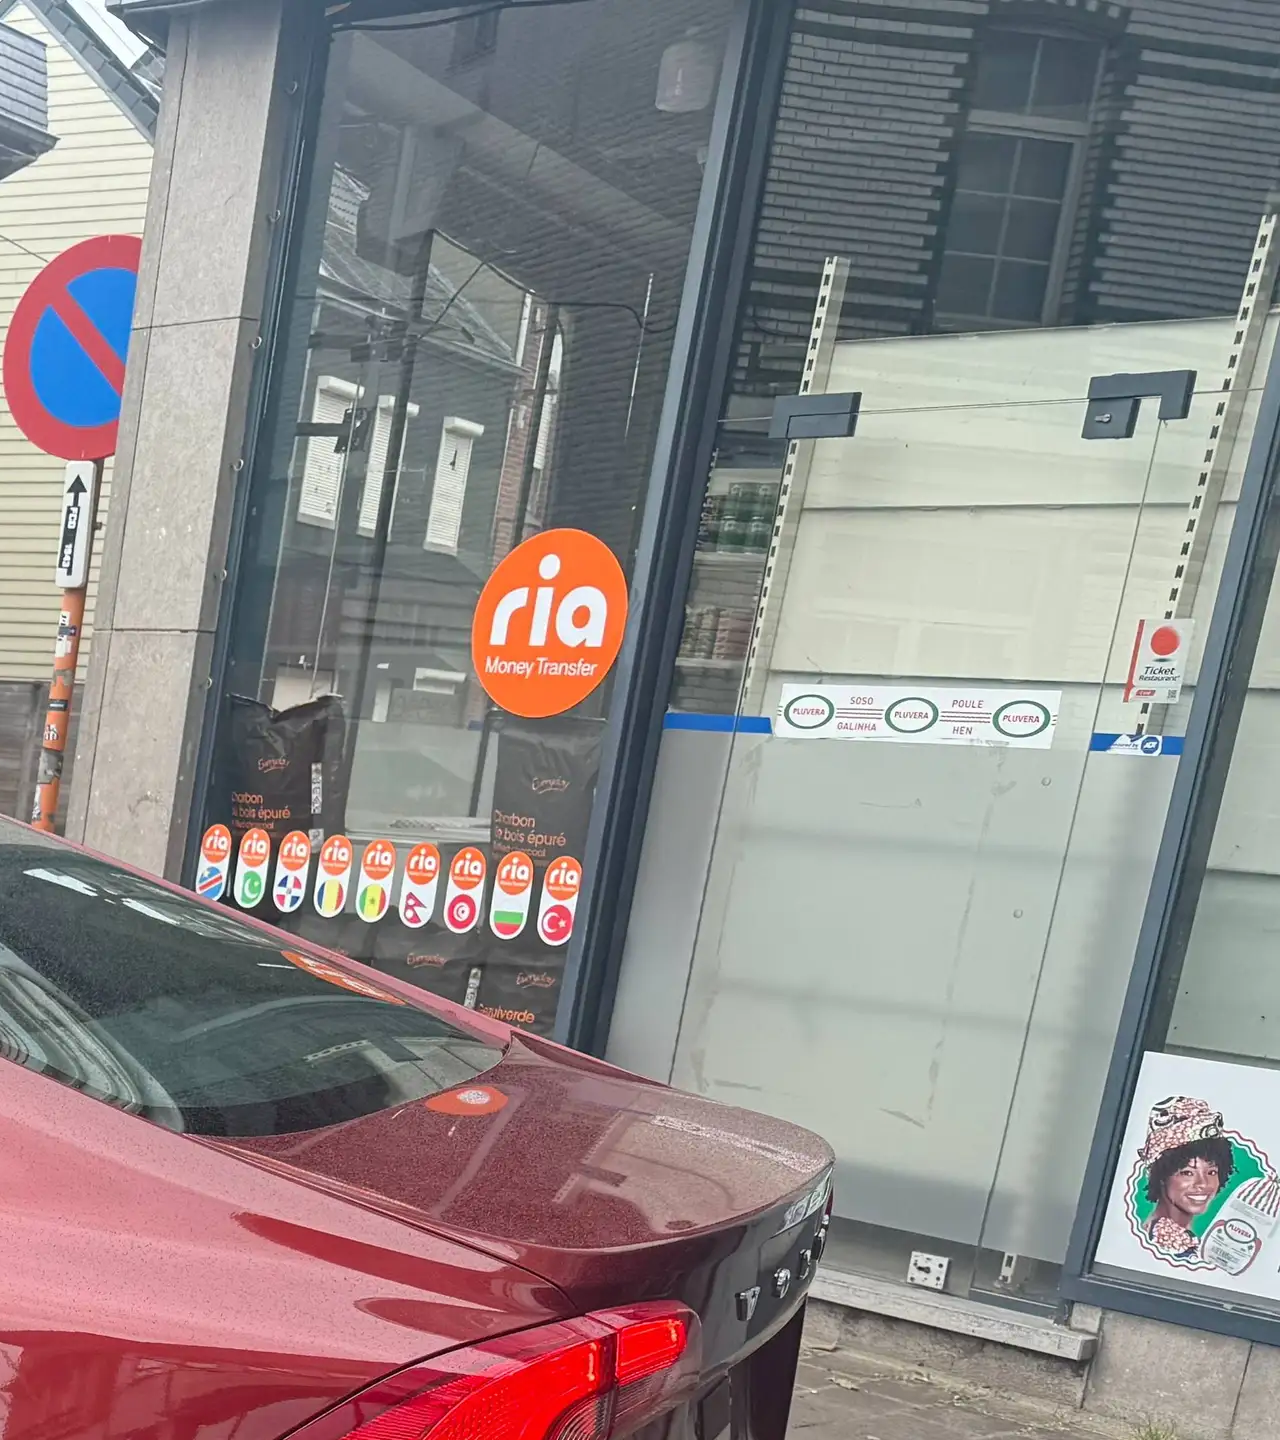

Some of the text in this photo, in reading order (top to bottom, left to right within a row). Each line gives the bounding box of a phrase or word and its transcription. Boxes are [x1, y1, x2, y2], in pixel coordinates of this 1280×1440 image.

[490, 554, 607, 648] ria
[485, 656, 598, 678] Money Transfer
[1144, 666, 1176, 675] Ticket
[850, 696, 874, 706] SOSO
[952, 699, 984, 709] POULE
[792, 708, 825, 716] PLUVERA
[894, 711, 929, 719] PLUVERA
[1002, 714, 1040, 723] PLUVERA
[837, 722, 877, 731] GALINHA
[952, 726, 973, 735] HEN
[206, 829, 229, 850] ria
[243, 833, 268, 852] ria
[282, 836, 308, 857] ria
[527, 829, 566, 848] épuré
[323, 840, 349, 861] ria
[366, 844, 392, 865] ria
[409, 848, 437, 871] ria
[454, 852, 482, 876] ria
[500, 857, 530, 881] ria
[549, 862, 579, 885] ria
